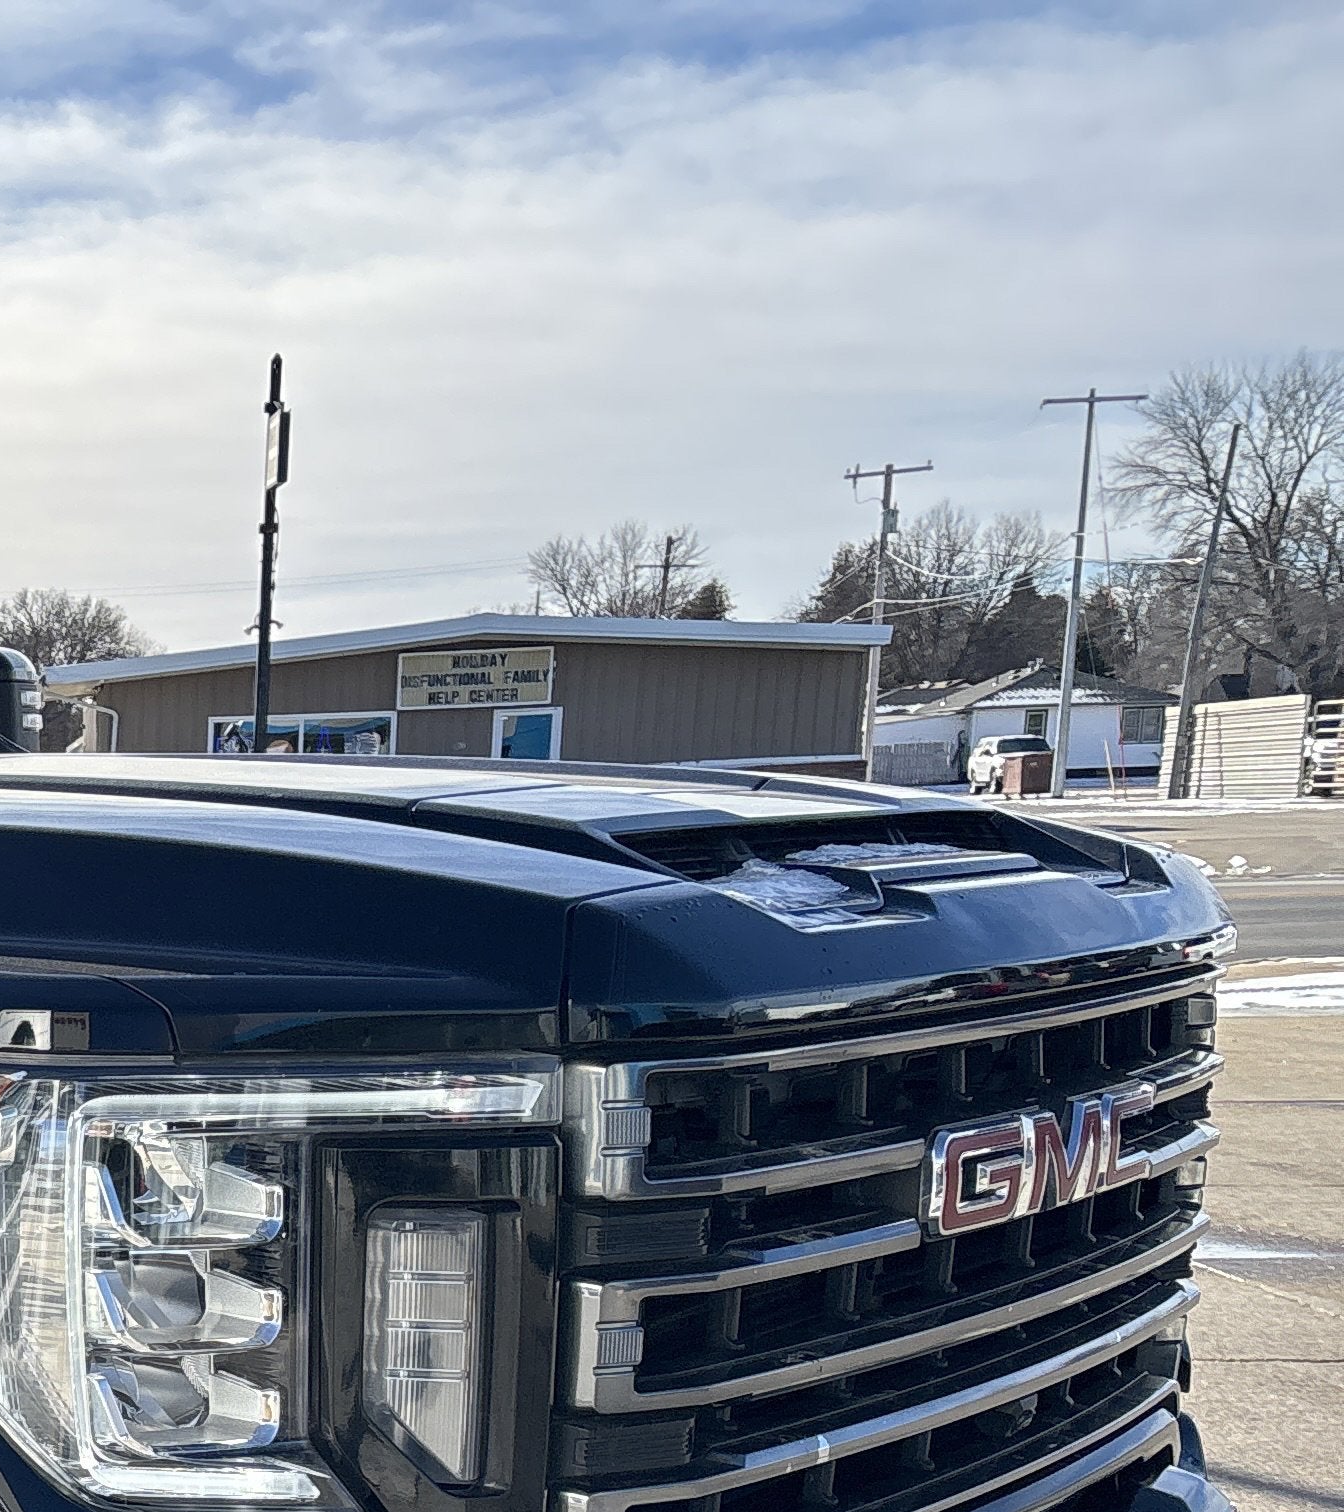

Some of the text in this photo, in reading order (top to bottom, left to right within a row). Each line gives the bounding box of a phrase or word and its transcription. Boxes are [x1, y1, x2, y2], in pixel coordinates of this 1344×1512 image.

[503, 668, 551, 684] FAMILY
[427, 687, 519, 705] HELP CENTER
[928, 1084, 1157, 1237] GMC
